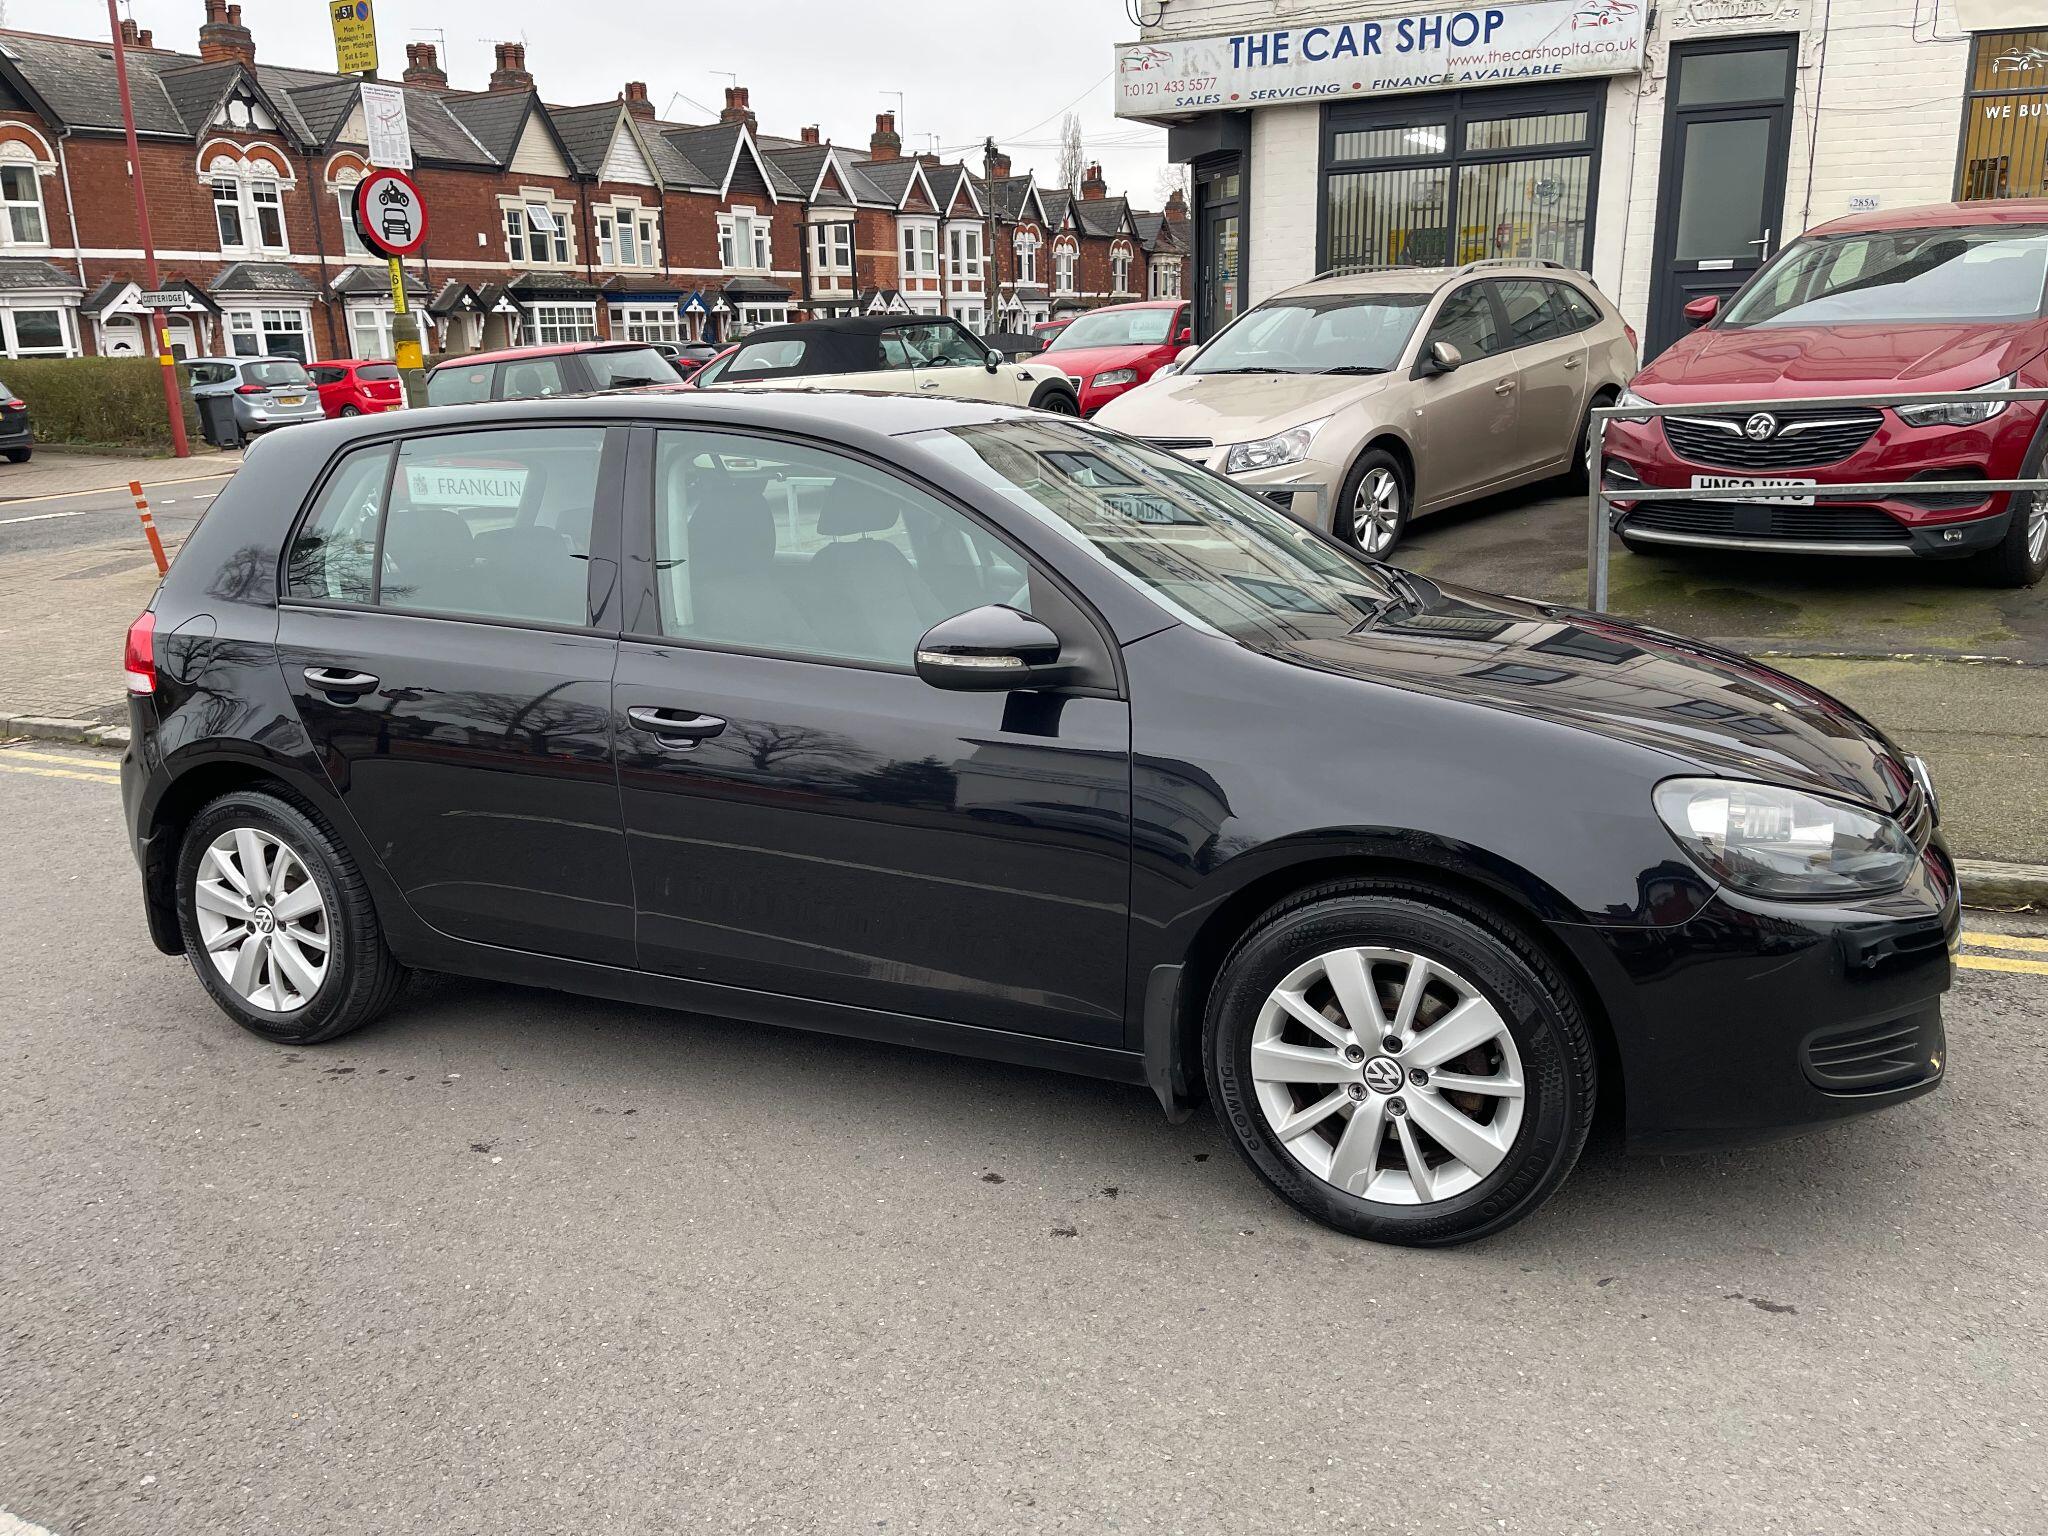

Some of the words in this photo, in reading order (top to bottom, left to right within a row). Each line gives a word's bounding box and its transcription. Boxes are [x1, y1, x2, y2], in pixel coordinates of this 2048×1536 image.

[1230, 32, 1289, 69] THE
[1302, 22, 1382, 62] CAR
[1395, 10, 1504, 53] SHOP
[1446, 37, 1637, 67] www.thecarshopltd.co.uk
[1164, 80, 1185, 93] 433
[1188, 77, 1217, 92] 5577
[1175, 93, 1221, 107] SALES
[1249, 83, 1341, 100] SERVICING
[1372, 73, 1454, 89] FINANCE
[1459, 63, 1562, 82] AVAILABLE
[1986, 105, 2012, 119] WE
[1852, 198, 1875, 207] 285A
[142, 294, 183, 303] COTTERIDGE
[437, 478, 521, 497] FRANKLIN
